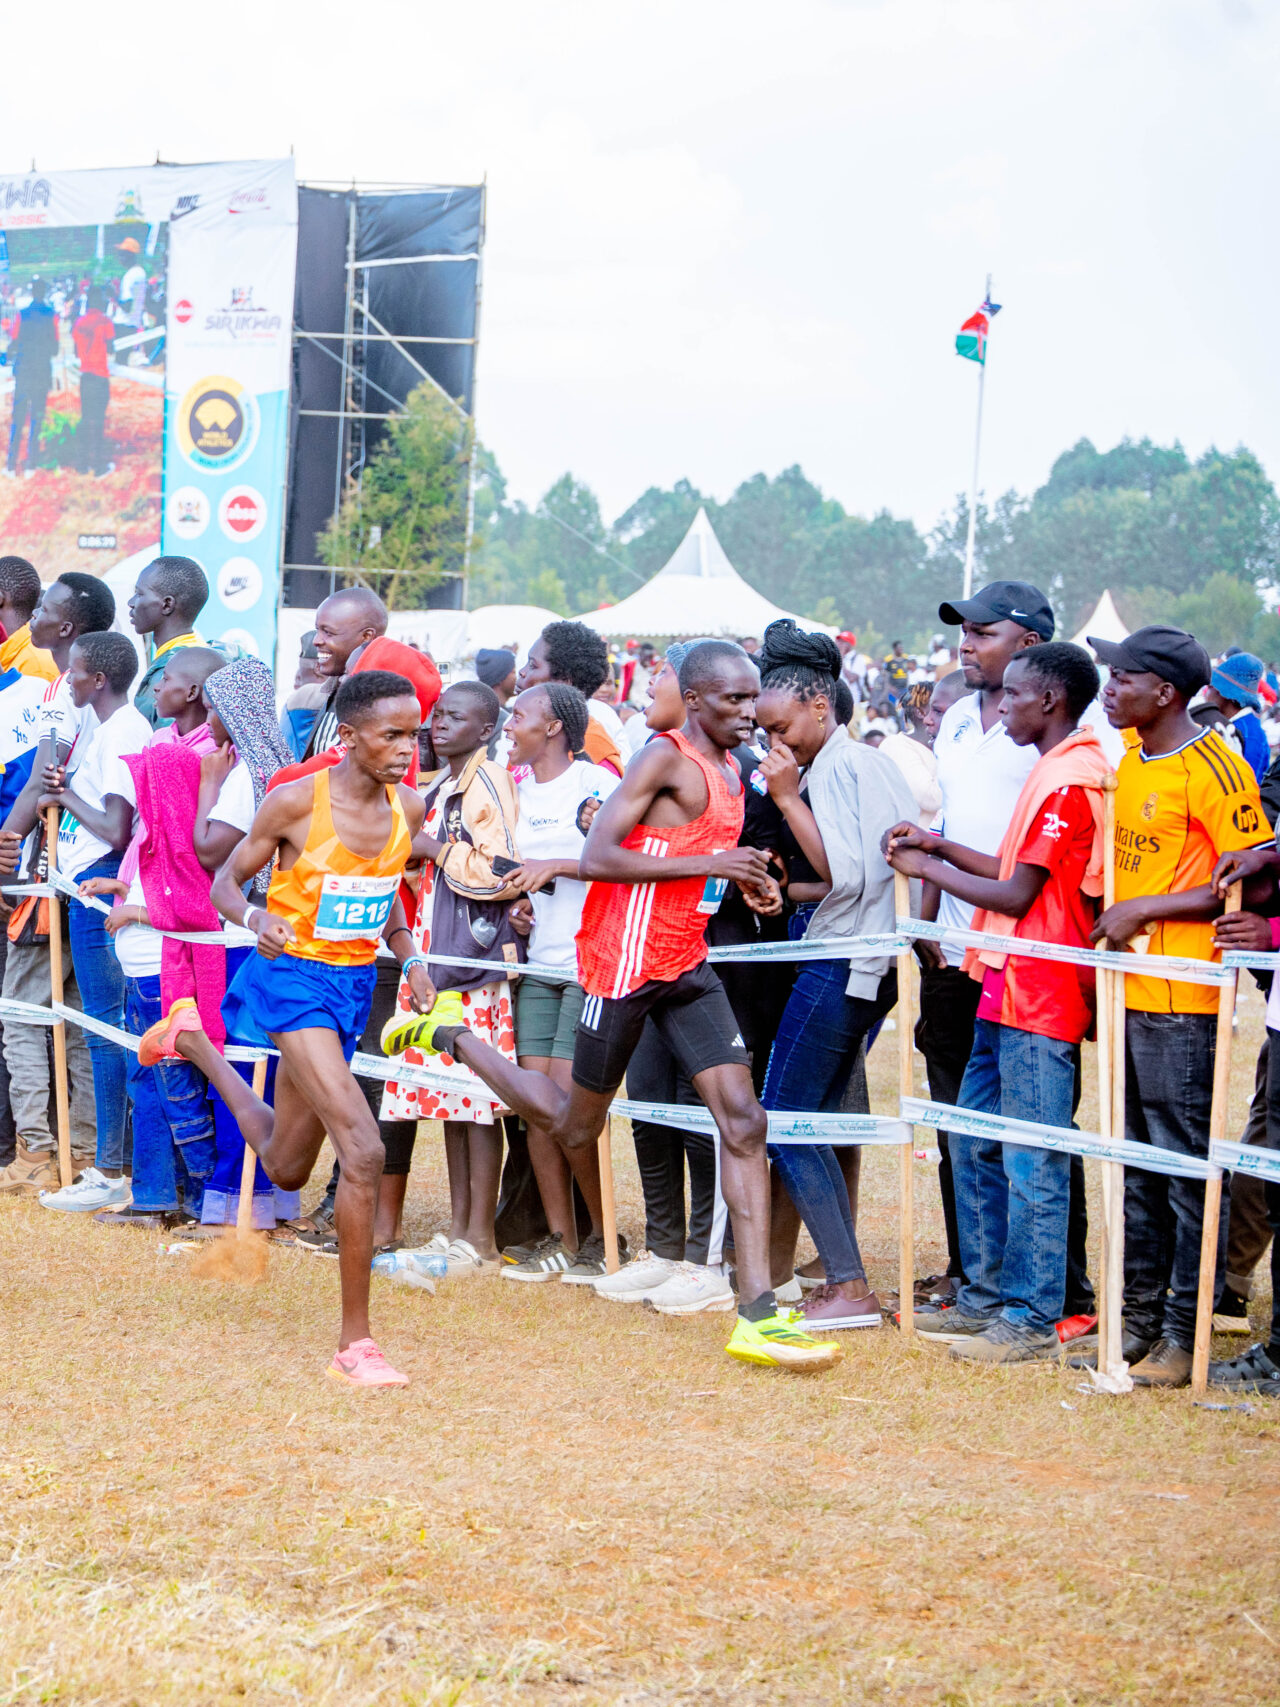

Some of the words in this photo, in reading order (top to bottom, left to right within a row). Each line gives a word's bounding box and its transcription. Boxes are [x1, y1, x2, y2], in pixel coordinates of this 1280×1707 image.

[204, 315, 282, 340] SIRIKWA
[1234, 806, 1258, 833] hp
[1114, 820, 1161, 854] irates
[333, 900, 390, 925] 1212
